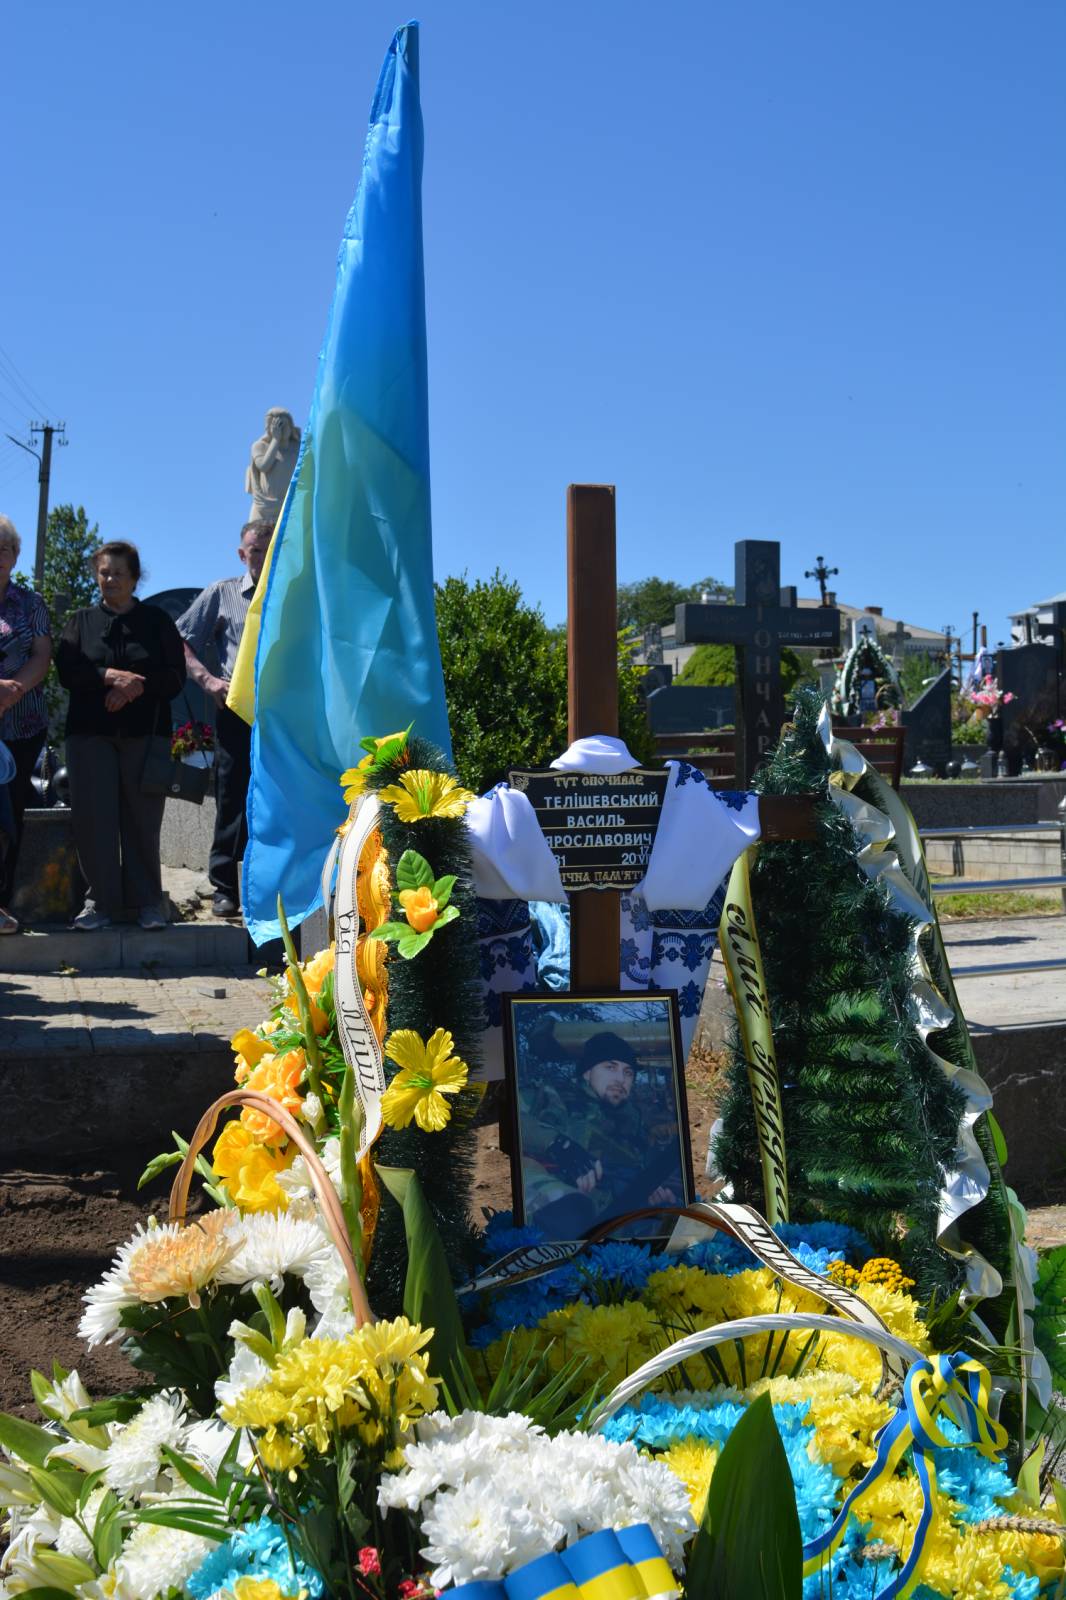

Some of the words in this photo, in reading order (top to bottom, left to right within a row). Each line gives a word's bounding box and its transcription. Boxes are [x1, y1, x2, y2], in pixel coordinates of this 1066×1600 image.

[554, 776, 579, 789] ТУТ
[581, 775, 644, 786] СПОЧИВАЄ
[567, 814, 626, 828] ВАСИЛЬ
[560, 872, 590, 882] ІЧНА
[335, 910, 356, 955] Від
